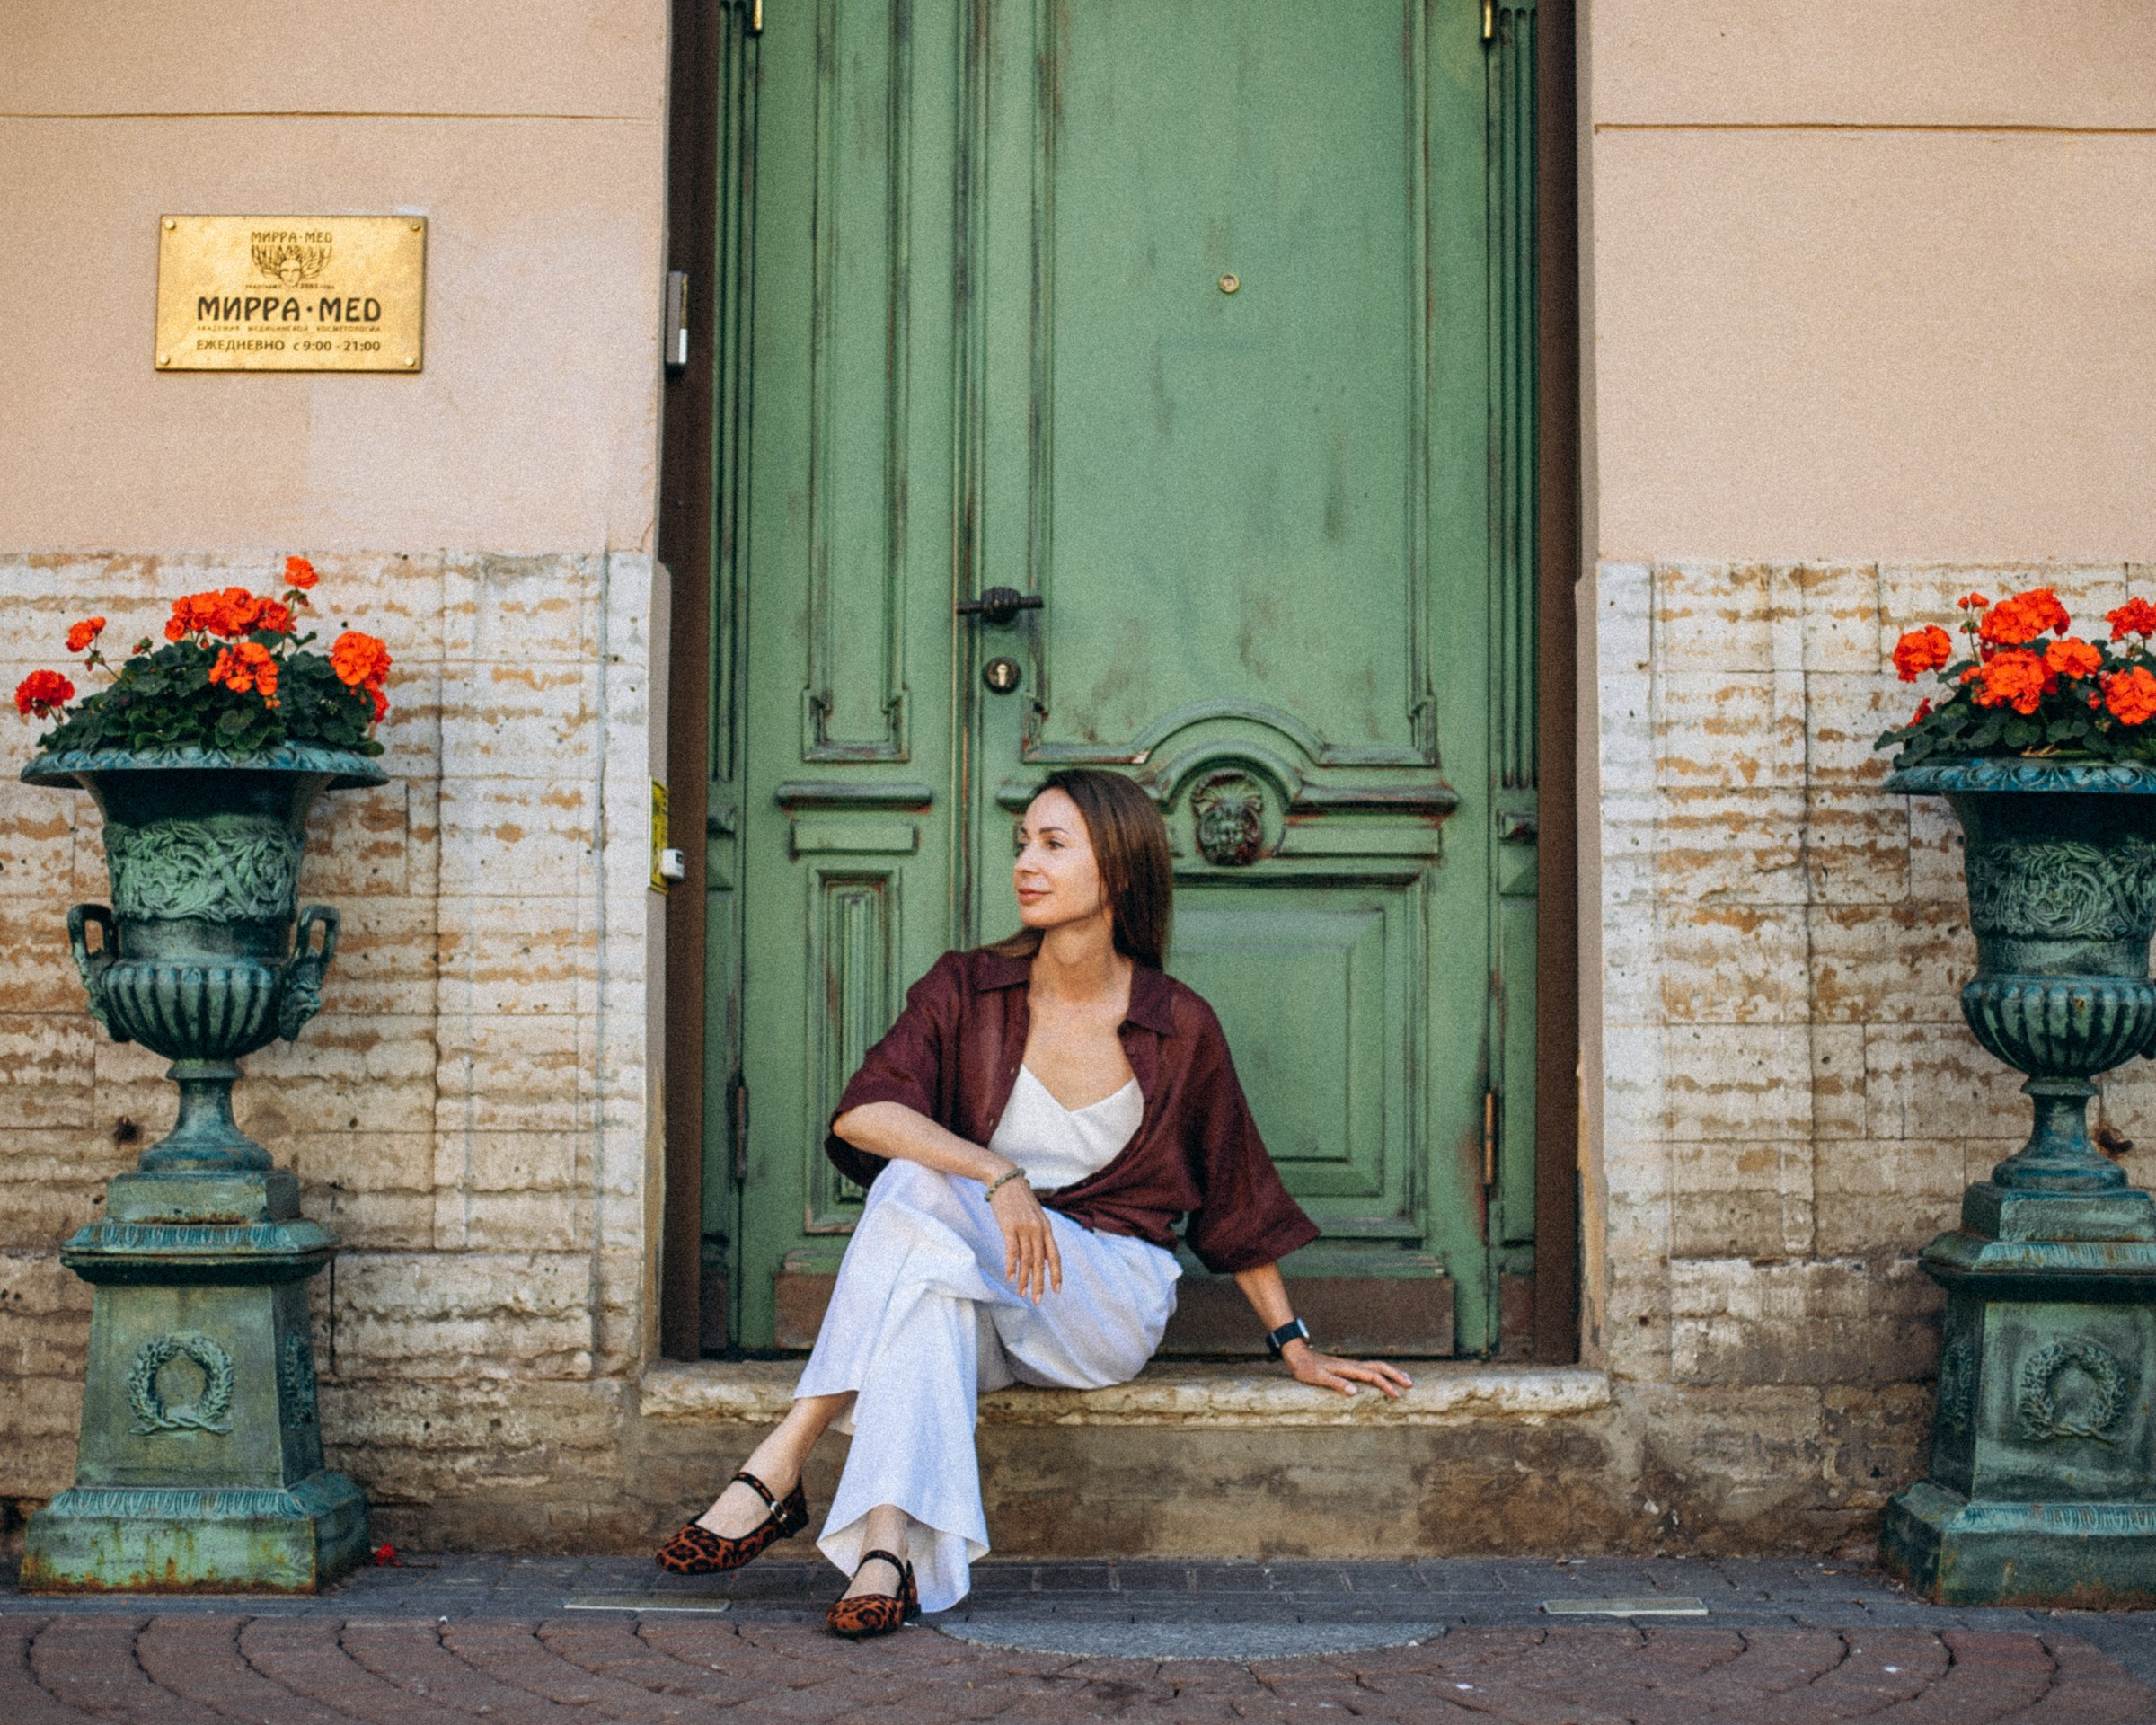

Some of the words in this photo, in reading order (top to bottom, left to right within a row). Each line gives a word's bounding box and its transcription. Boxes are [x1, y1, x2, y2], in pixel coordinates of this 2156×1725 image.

[196, 340, 285, 352] ЕЖЕДНЕВНО
[303, 341, 332, 351] 9:00
[343, 341, 381, 351] 21:00
